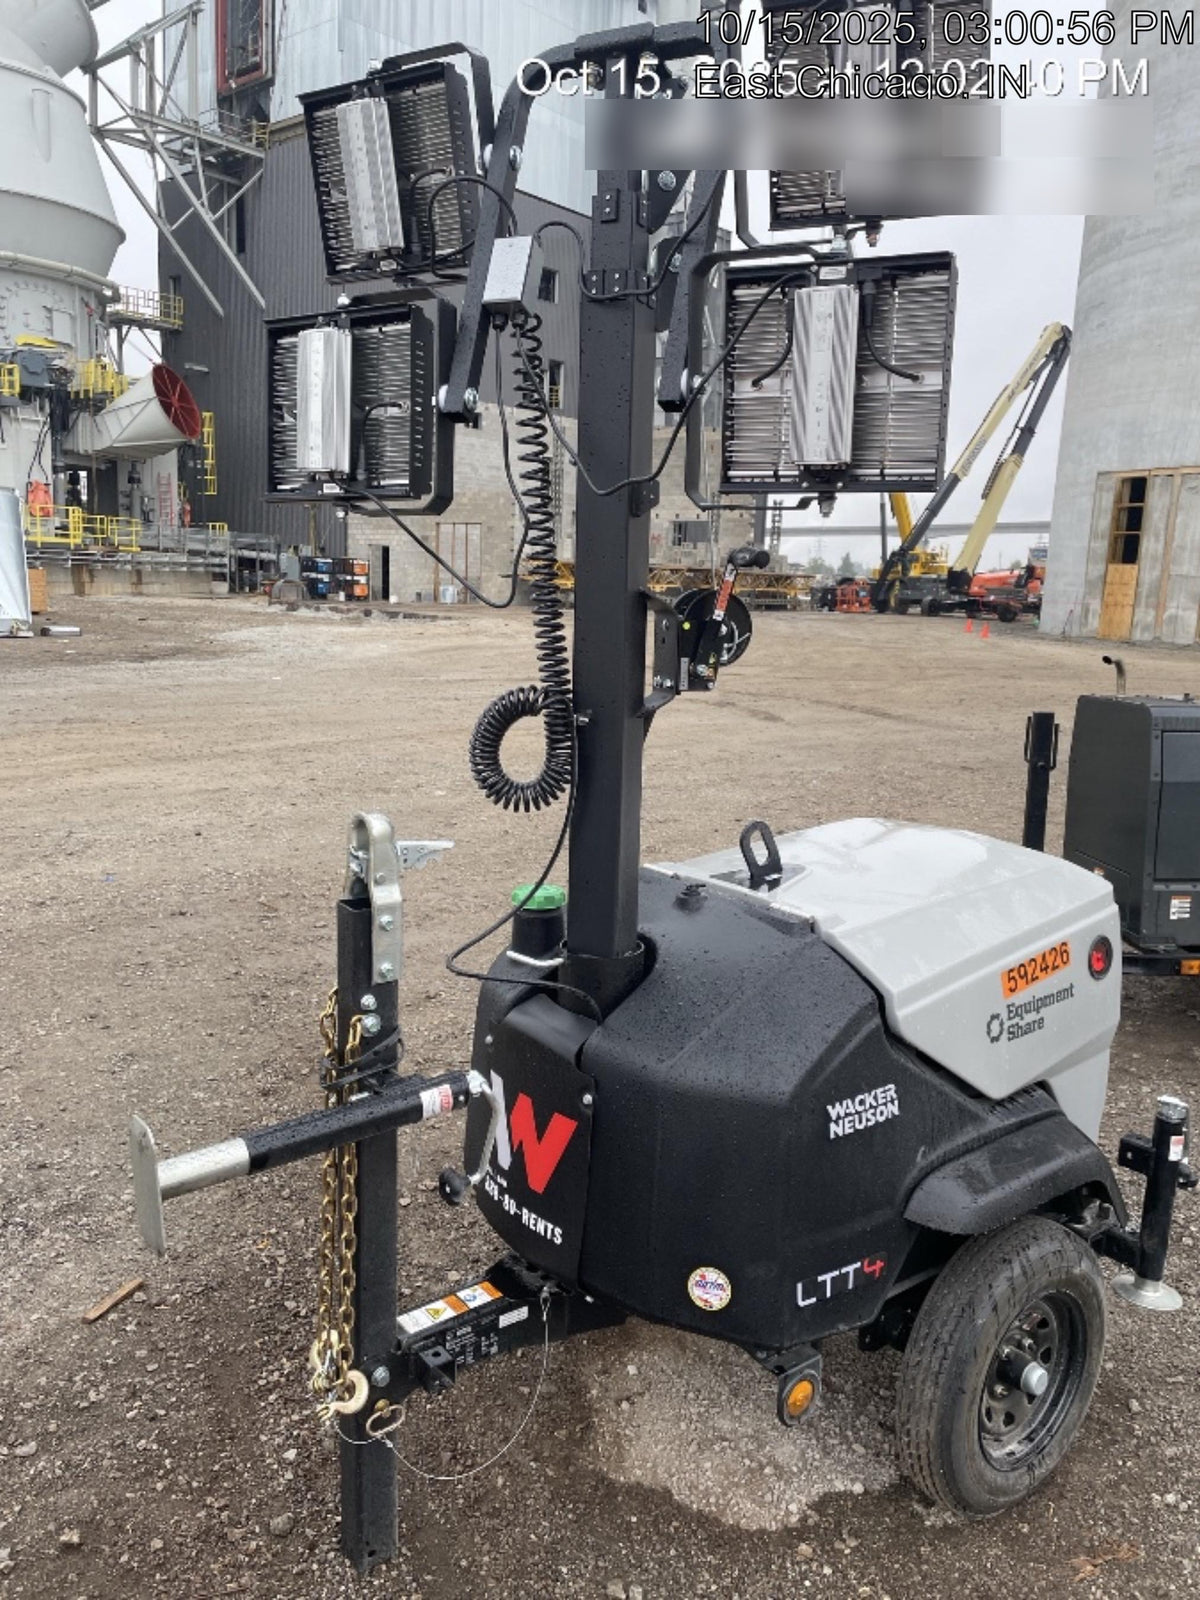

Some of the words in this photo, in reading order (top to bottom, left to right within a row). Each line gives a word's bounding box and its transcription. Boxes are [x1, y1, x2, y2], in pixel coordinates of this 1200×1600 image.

[1007, 942, 1069, 993] 592426
[1006, 982, 1074, 1021] Equipment
[1007, 1016, 1045, 1042] Share
[826, 1083, 898, 1121] WACKER
[829, 1099, 900, 1140] NEUSON
